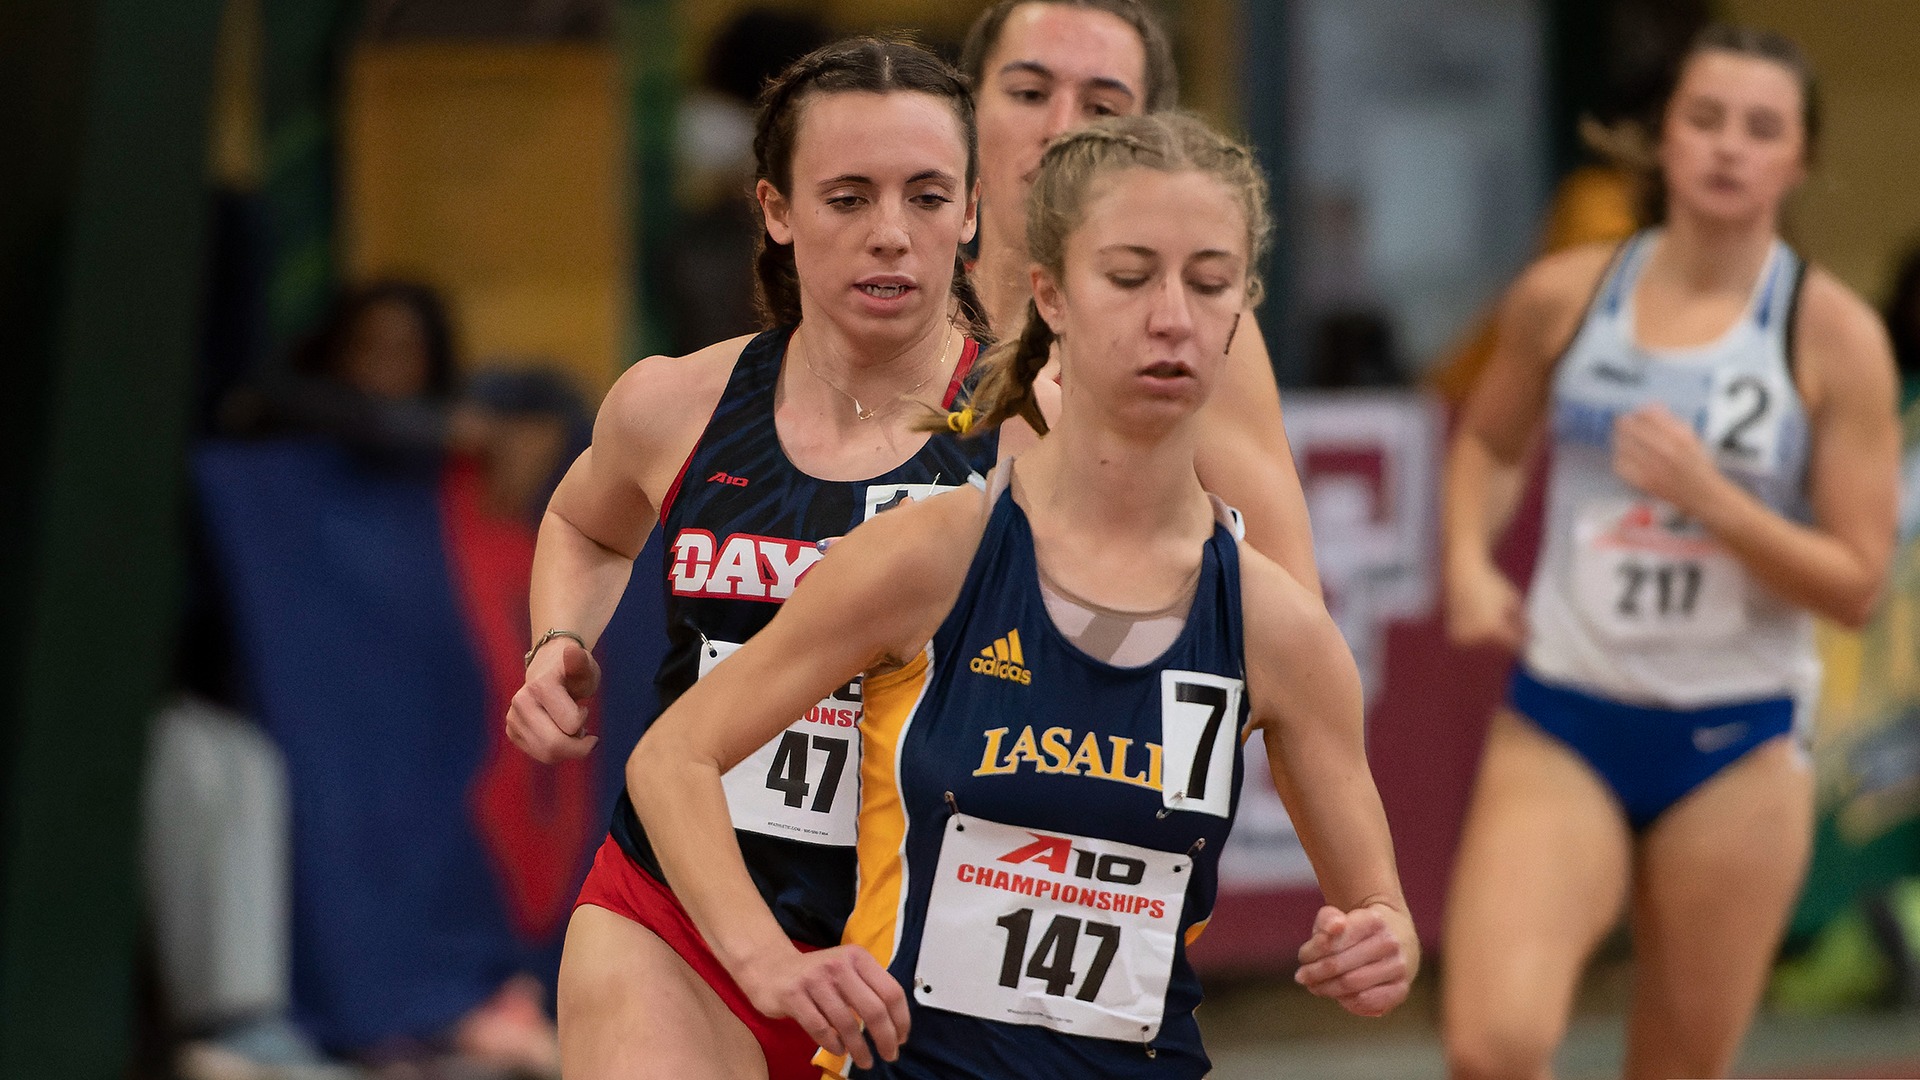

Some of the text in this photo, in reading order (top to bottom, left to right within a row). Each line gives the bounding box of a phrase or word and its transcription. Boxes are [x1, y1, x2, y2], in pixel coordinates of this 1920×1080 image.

[1718, 376, 1770, 456] 2
[706, 471, 749, 487] A10
[1616, 562, 1702, 615] 217
[969, 657, 1031, 686] adidas
[1175, 681, 1227, 800] 7
[765, 729, 849, 814] 47
[996, 831, 1147, 885] A10
[957, 863, 1165, 919] CHAMPIONSHIPS
[997, 908, 1121, 1003] 147
